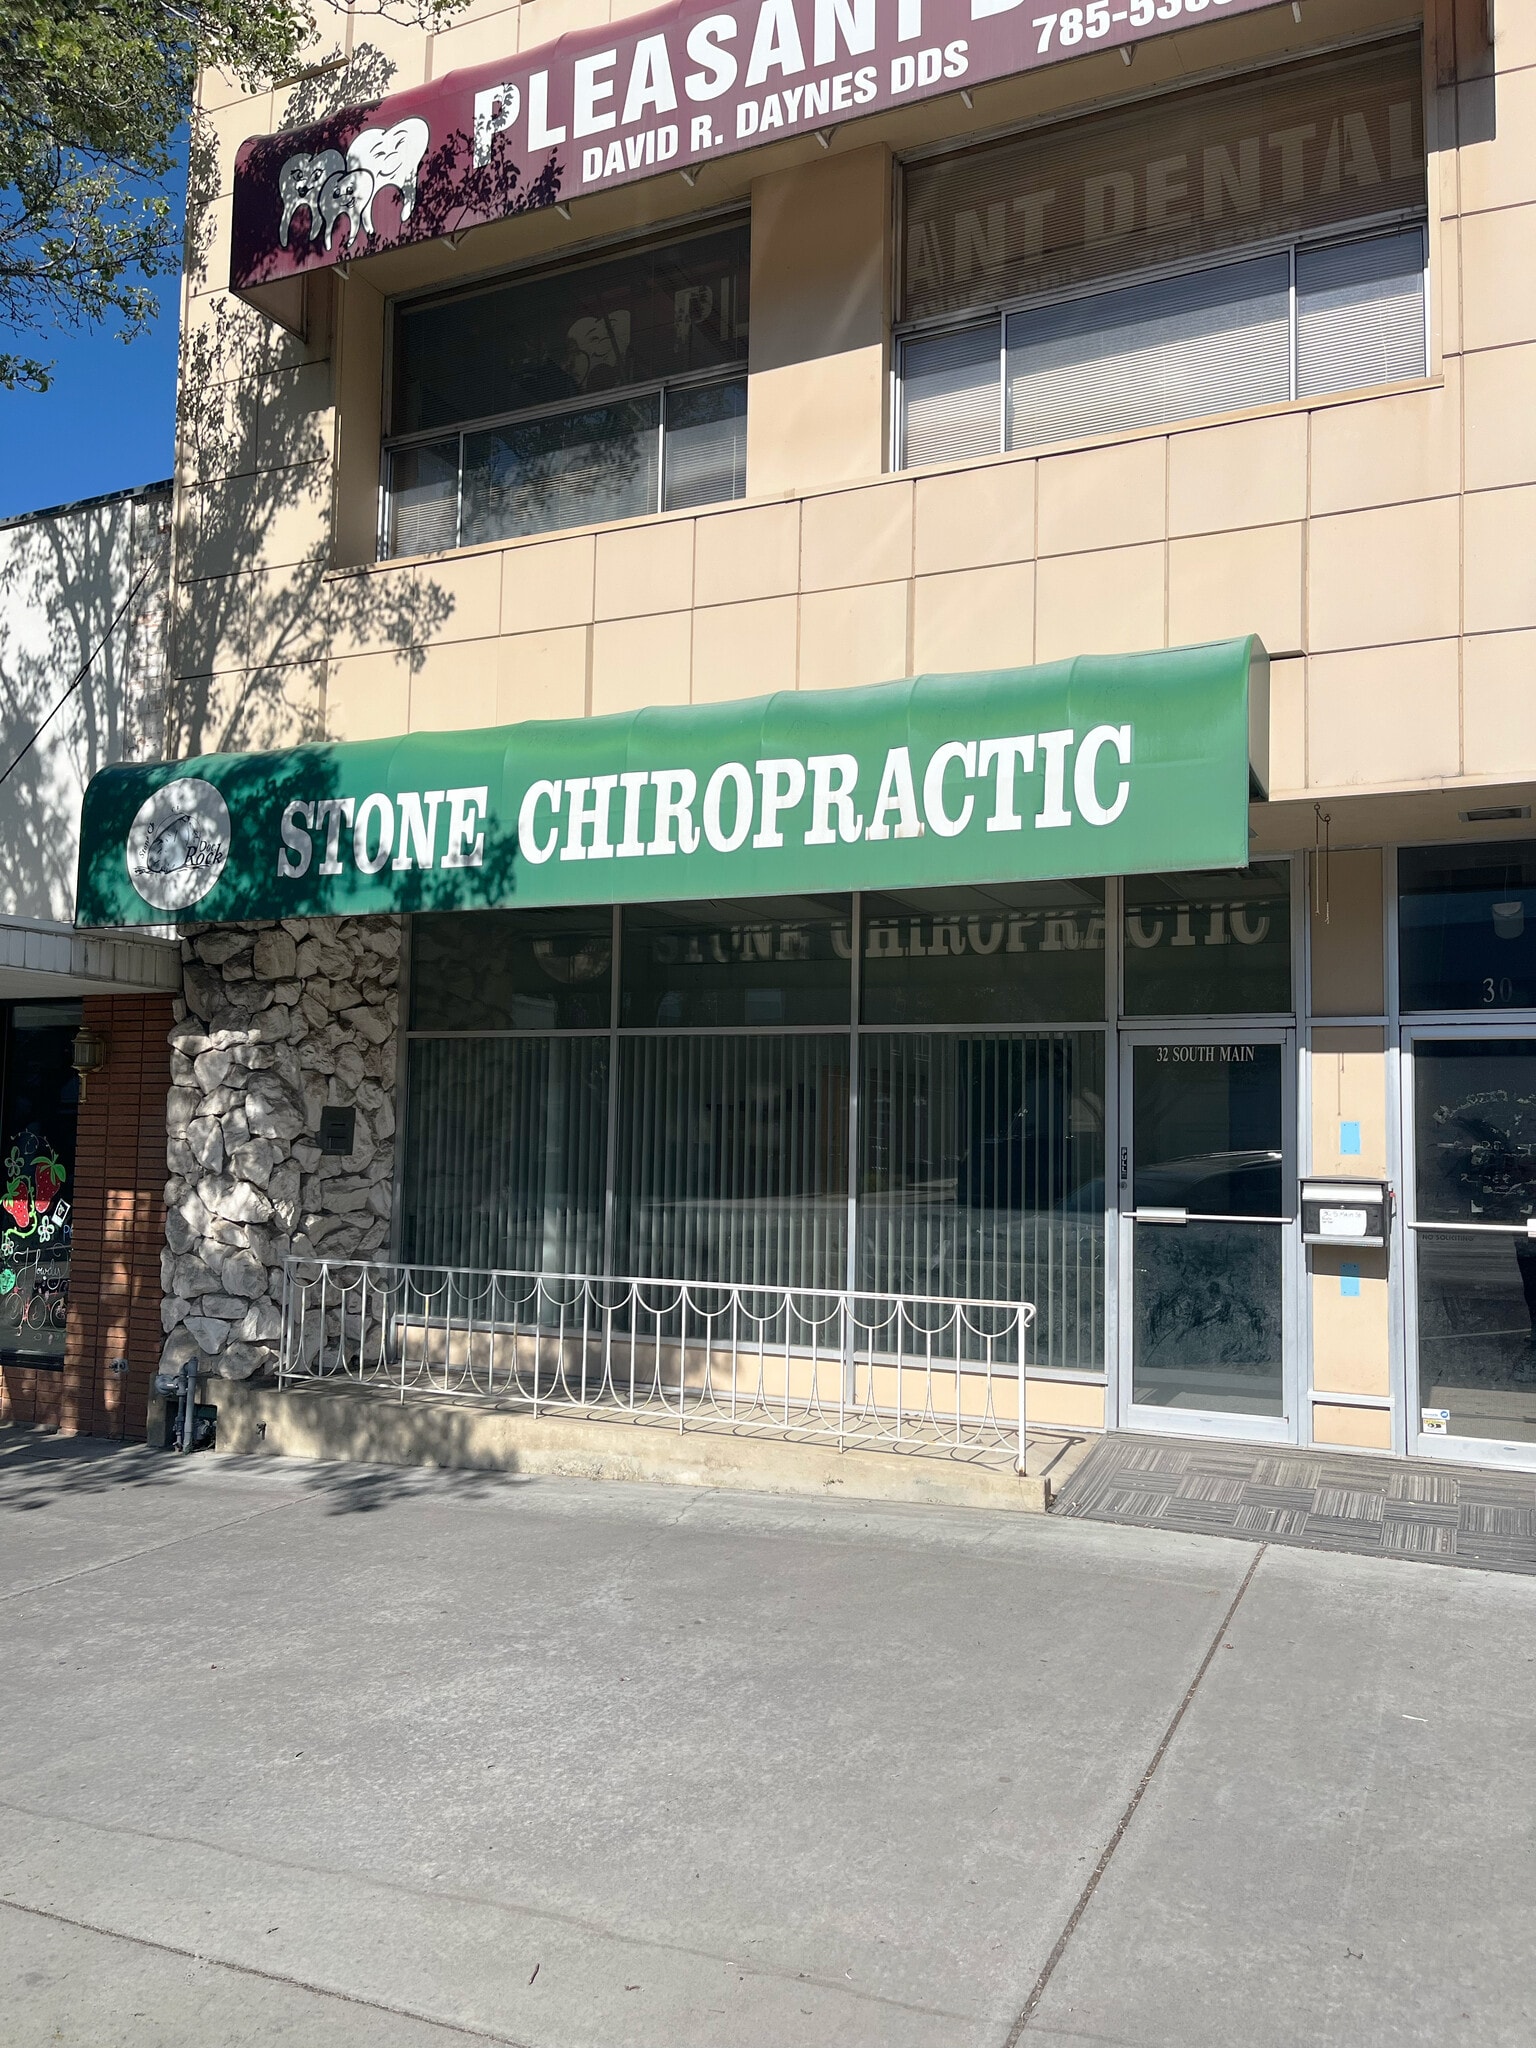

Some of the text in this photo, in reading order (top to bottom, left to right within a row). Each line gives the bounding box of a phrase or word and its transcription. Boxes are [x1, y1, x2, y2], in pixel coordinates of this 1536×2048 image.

[1032, 0, 1232, 54] 785-53
[582, 40, 969, 183] DAVID R. DAYNES DDS
[277, 724, 1132, 878] STONE CHIROPRACTIC
[184, 843, 223, 865] Rock
[1482, 977, 1513, 1003] 30
[1156, 1046, 1255, 1062] 32 SOUTH MAIN
[1435, 1234, 1474, 1242] SOLICITING
[13, 1246, 66, 1290] Howdy
